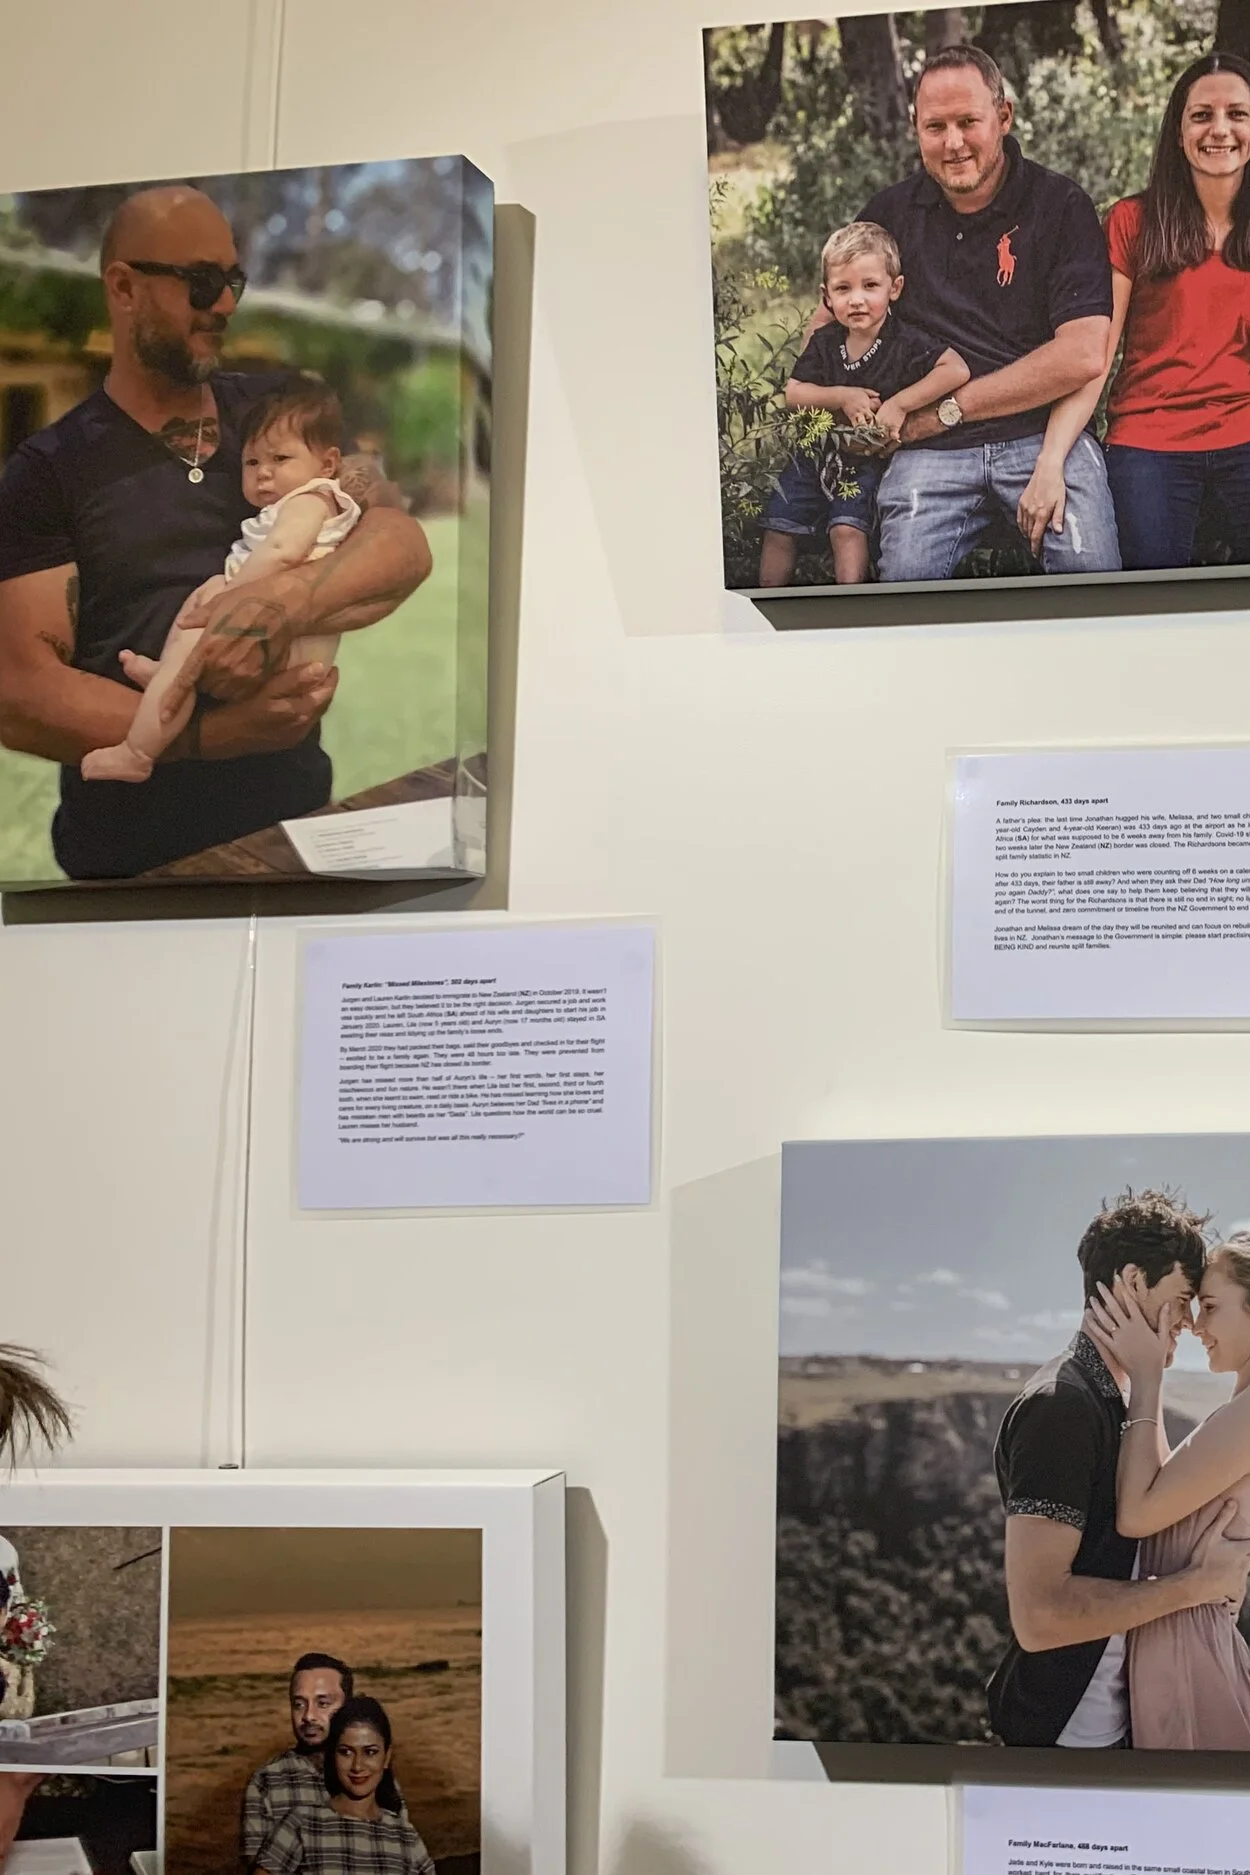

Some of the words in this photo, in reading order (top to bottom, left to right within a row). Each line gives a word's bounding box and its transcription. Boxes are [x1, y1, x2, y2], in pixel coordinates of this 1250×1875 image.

[996, 826, 1021, 834] year-old
[1152, 823, 1168, 831] days
[1205, 822, 1225, 830] airport
[1097, 842, 1112, 850] (NZ)
[995, 853, 1008, 861] split
[1009, 853, 1027, 861] family
